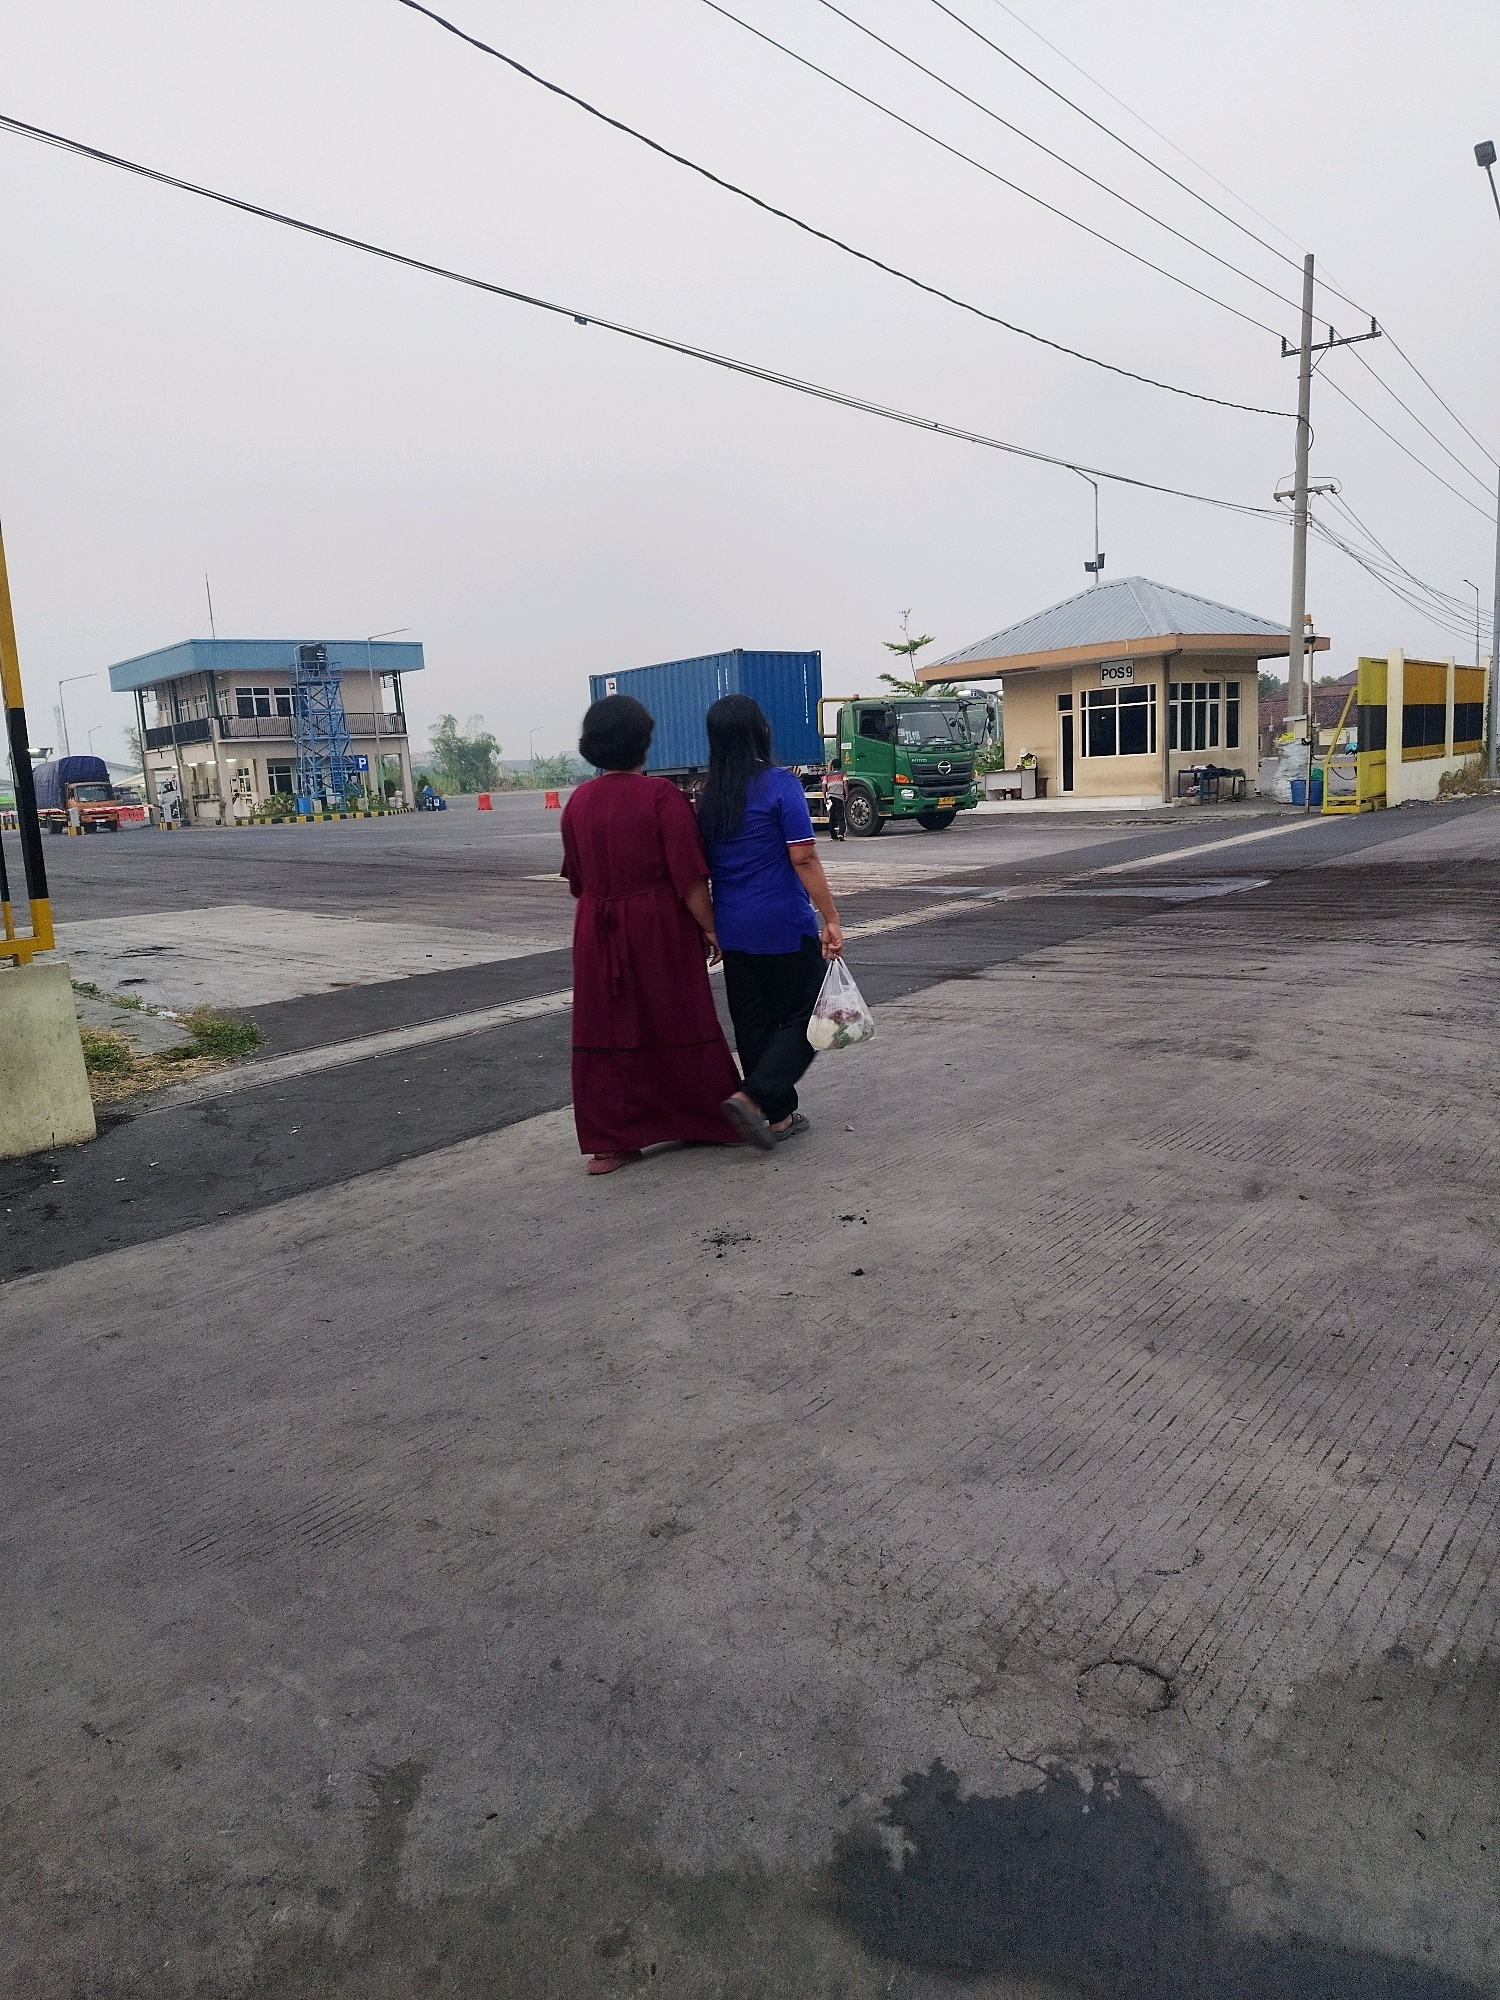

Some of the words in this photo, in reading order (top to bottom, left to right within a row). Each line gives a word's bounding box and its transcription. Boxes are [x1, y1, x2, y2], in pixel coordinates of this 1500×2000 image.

[1102, 667, 1124, 680] POS
[1126, 666, 1132, 678] 9
[358, 758, 366, 768] P
